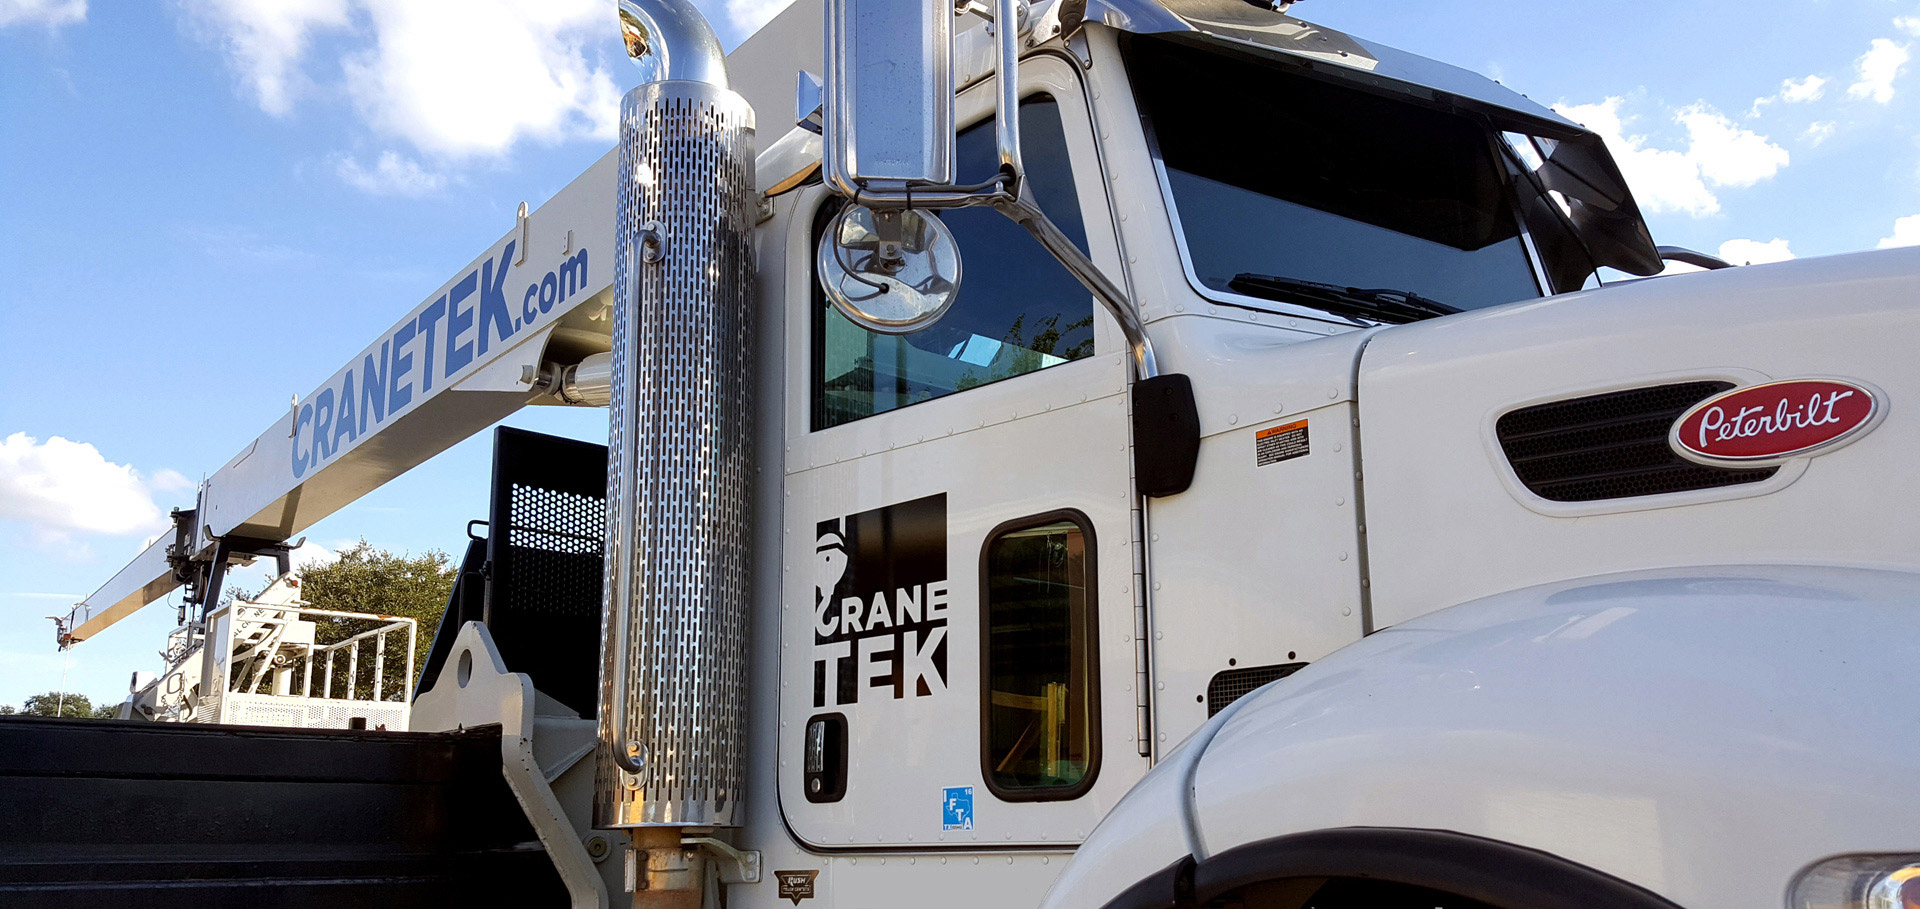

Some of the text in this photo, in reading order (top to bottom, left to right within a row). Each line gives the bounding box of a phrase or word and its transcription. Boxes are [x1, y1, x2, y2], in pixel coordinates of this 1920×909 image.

[1699, 390, 1854, 448] Peterbilt
[815, 579, 948, 637] CRANE
[814, 625, 948, 708] TEK
